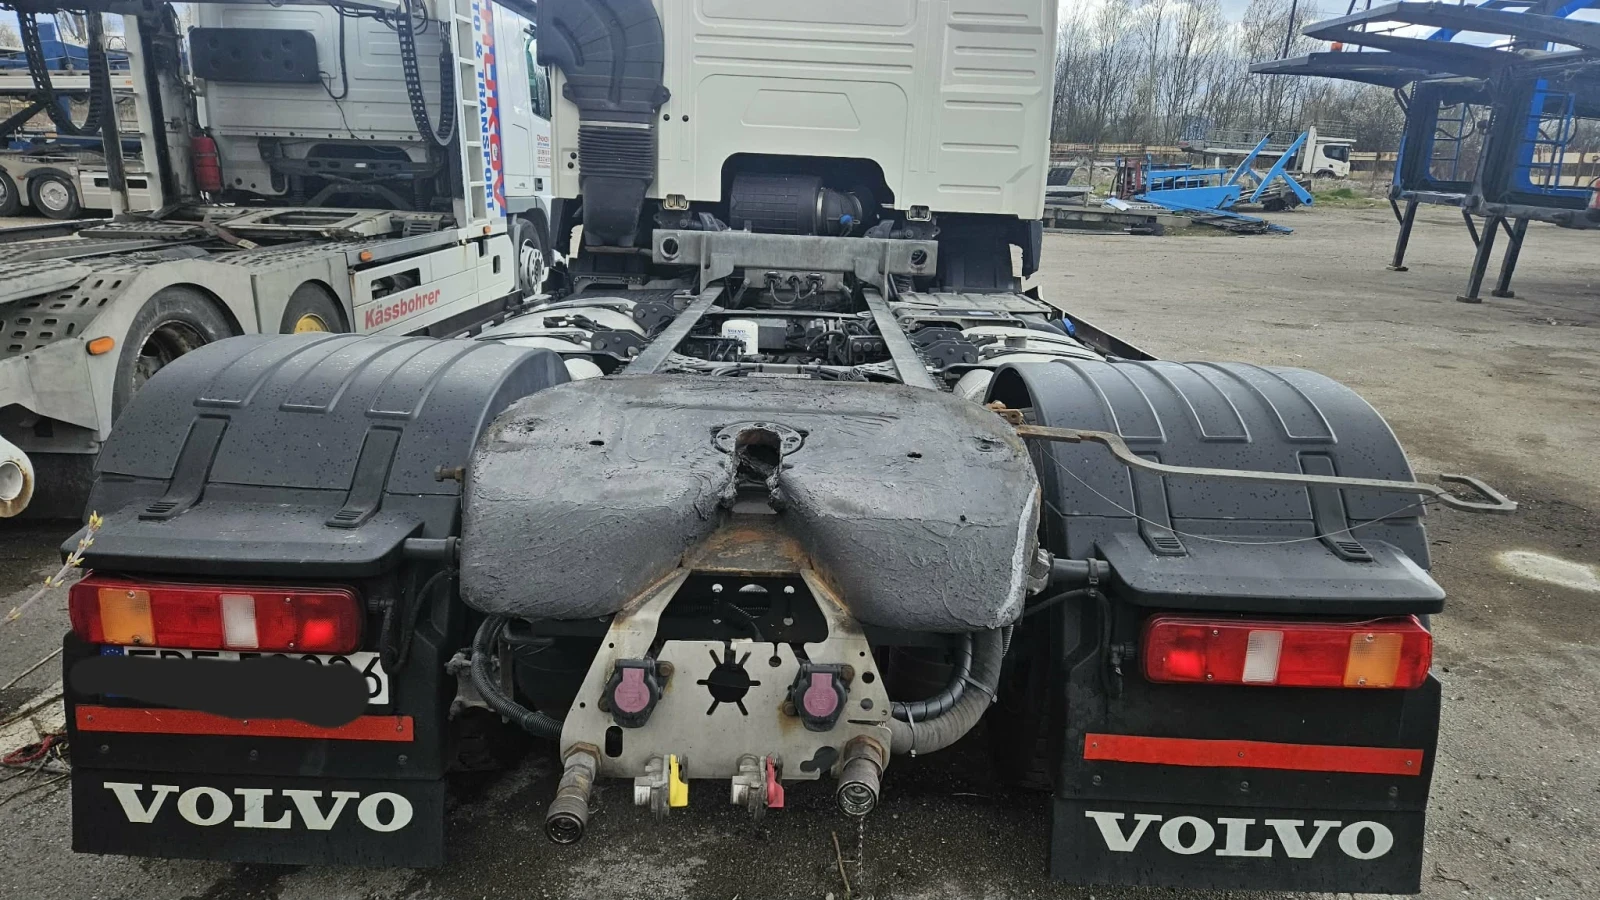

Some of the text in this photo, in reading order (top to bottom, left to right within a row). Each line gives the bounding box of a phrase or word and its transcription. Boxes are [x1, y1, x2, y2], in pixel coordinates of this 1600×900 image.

[475, 41, 483, 58] &
[480, 0, 507, 208] HUKOV
[478, 69, 494, 210] TRANSPORT
[365, 289, 440, 330] Kässbohrer
[103, 781, 413, 832] VOLVO
[1085, 810, 1394, 860] VOLVO
